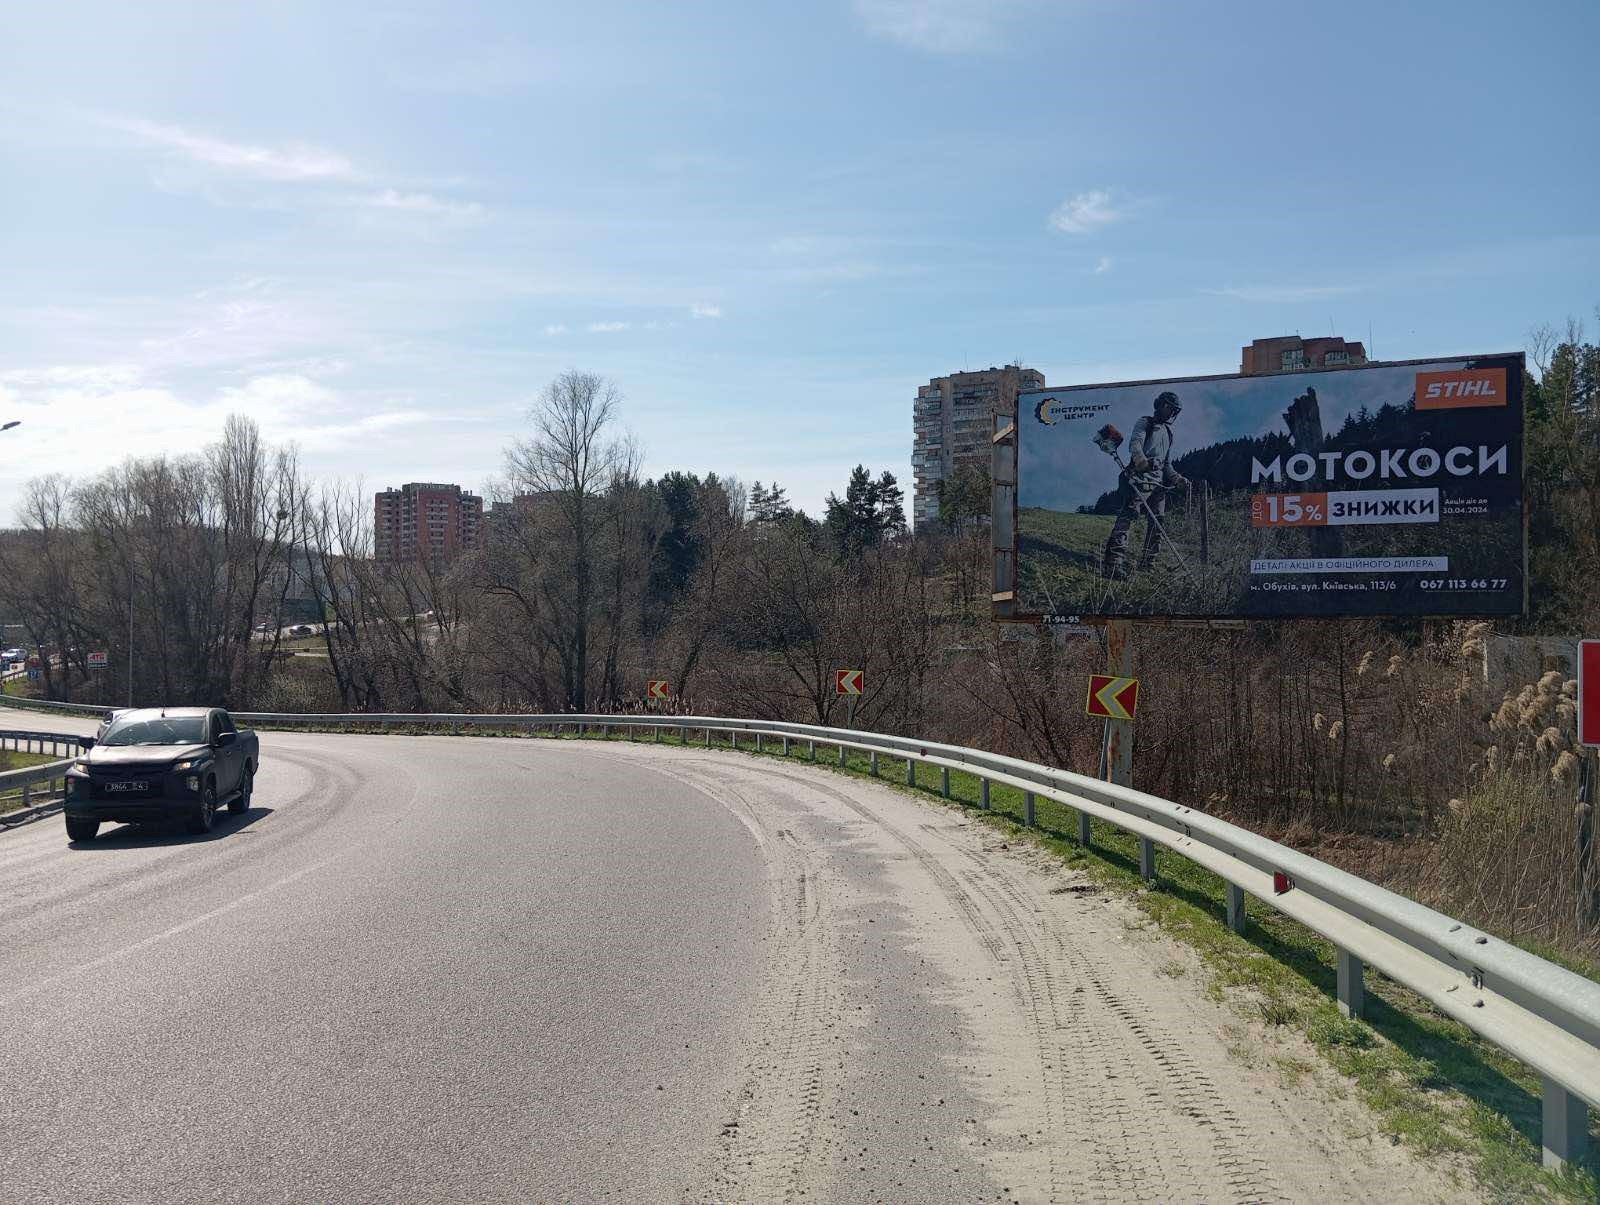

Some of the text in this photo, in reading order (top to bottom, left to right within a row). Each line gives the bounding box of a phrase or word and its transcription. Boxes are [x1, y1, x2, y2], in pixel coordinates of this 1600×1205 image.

[1424, 380, 1497, 399] STIHL
[1064, 412, 1095, 420] ЦЕНТР
[1251, 443, 1507, 484] МОТОКОСИ
[1265, 495, 1435, 522] 15% ЗНИЖКИ
[1442, 506, 1488, 514] 30.04.2024
[1393, 559, 1434, 569] ДИЛЕРА
[1301, 583, 1320, 593] вул.
[1370, 580, 1397, 592] 113/6
[1419, 578, 1508, 589] 067 113 66 77
